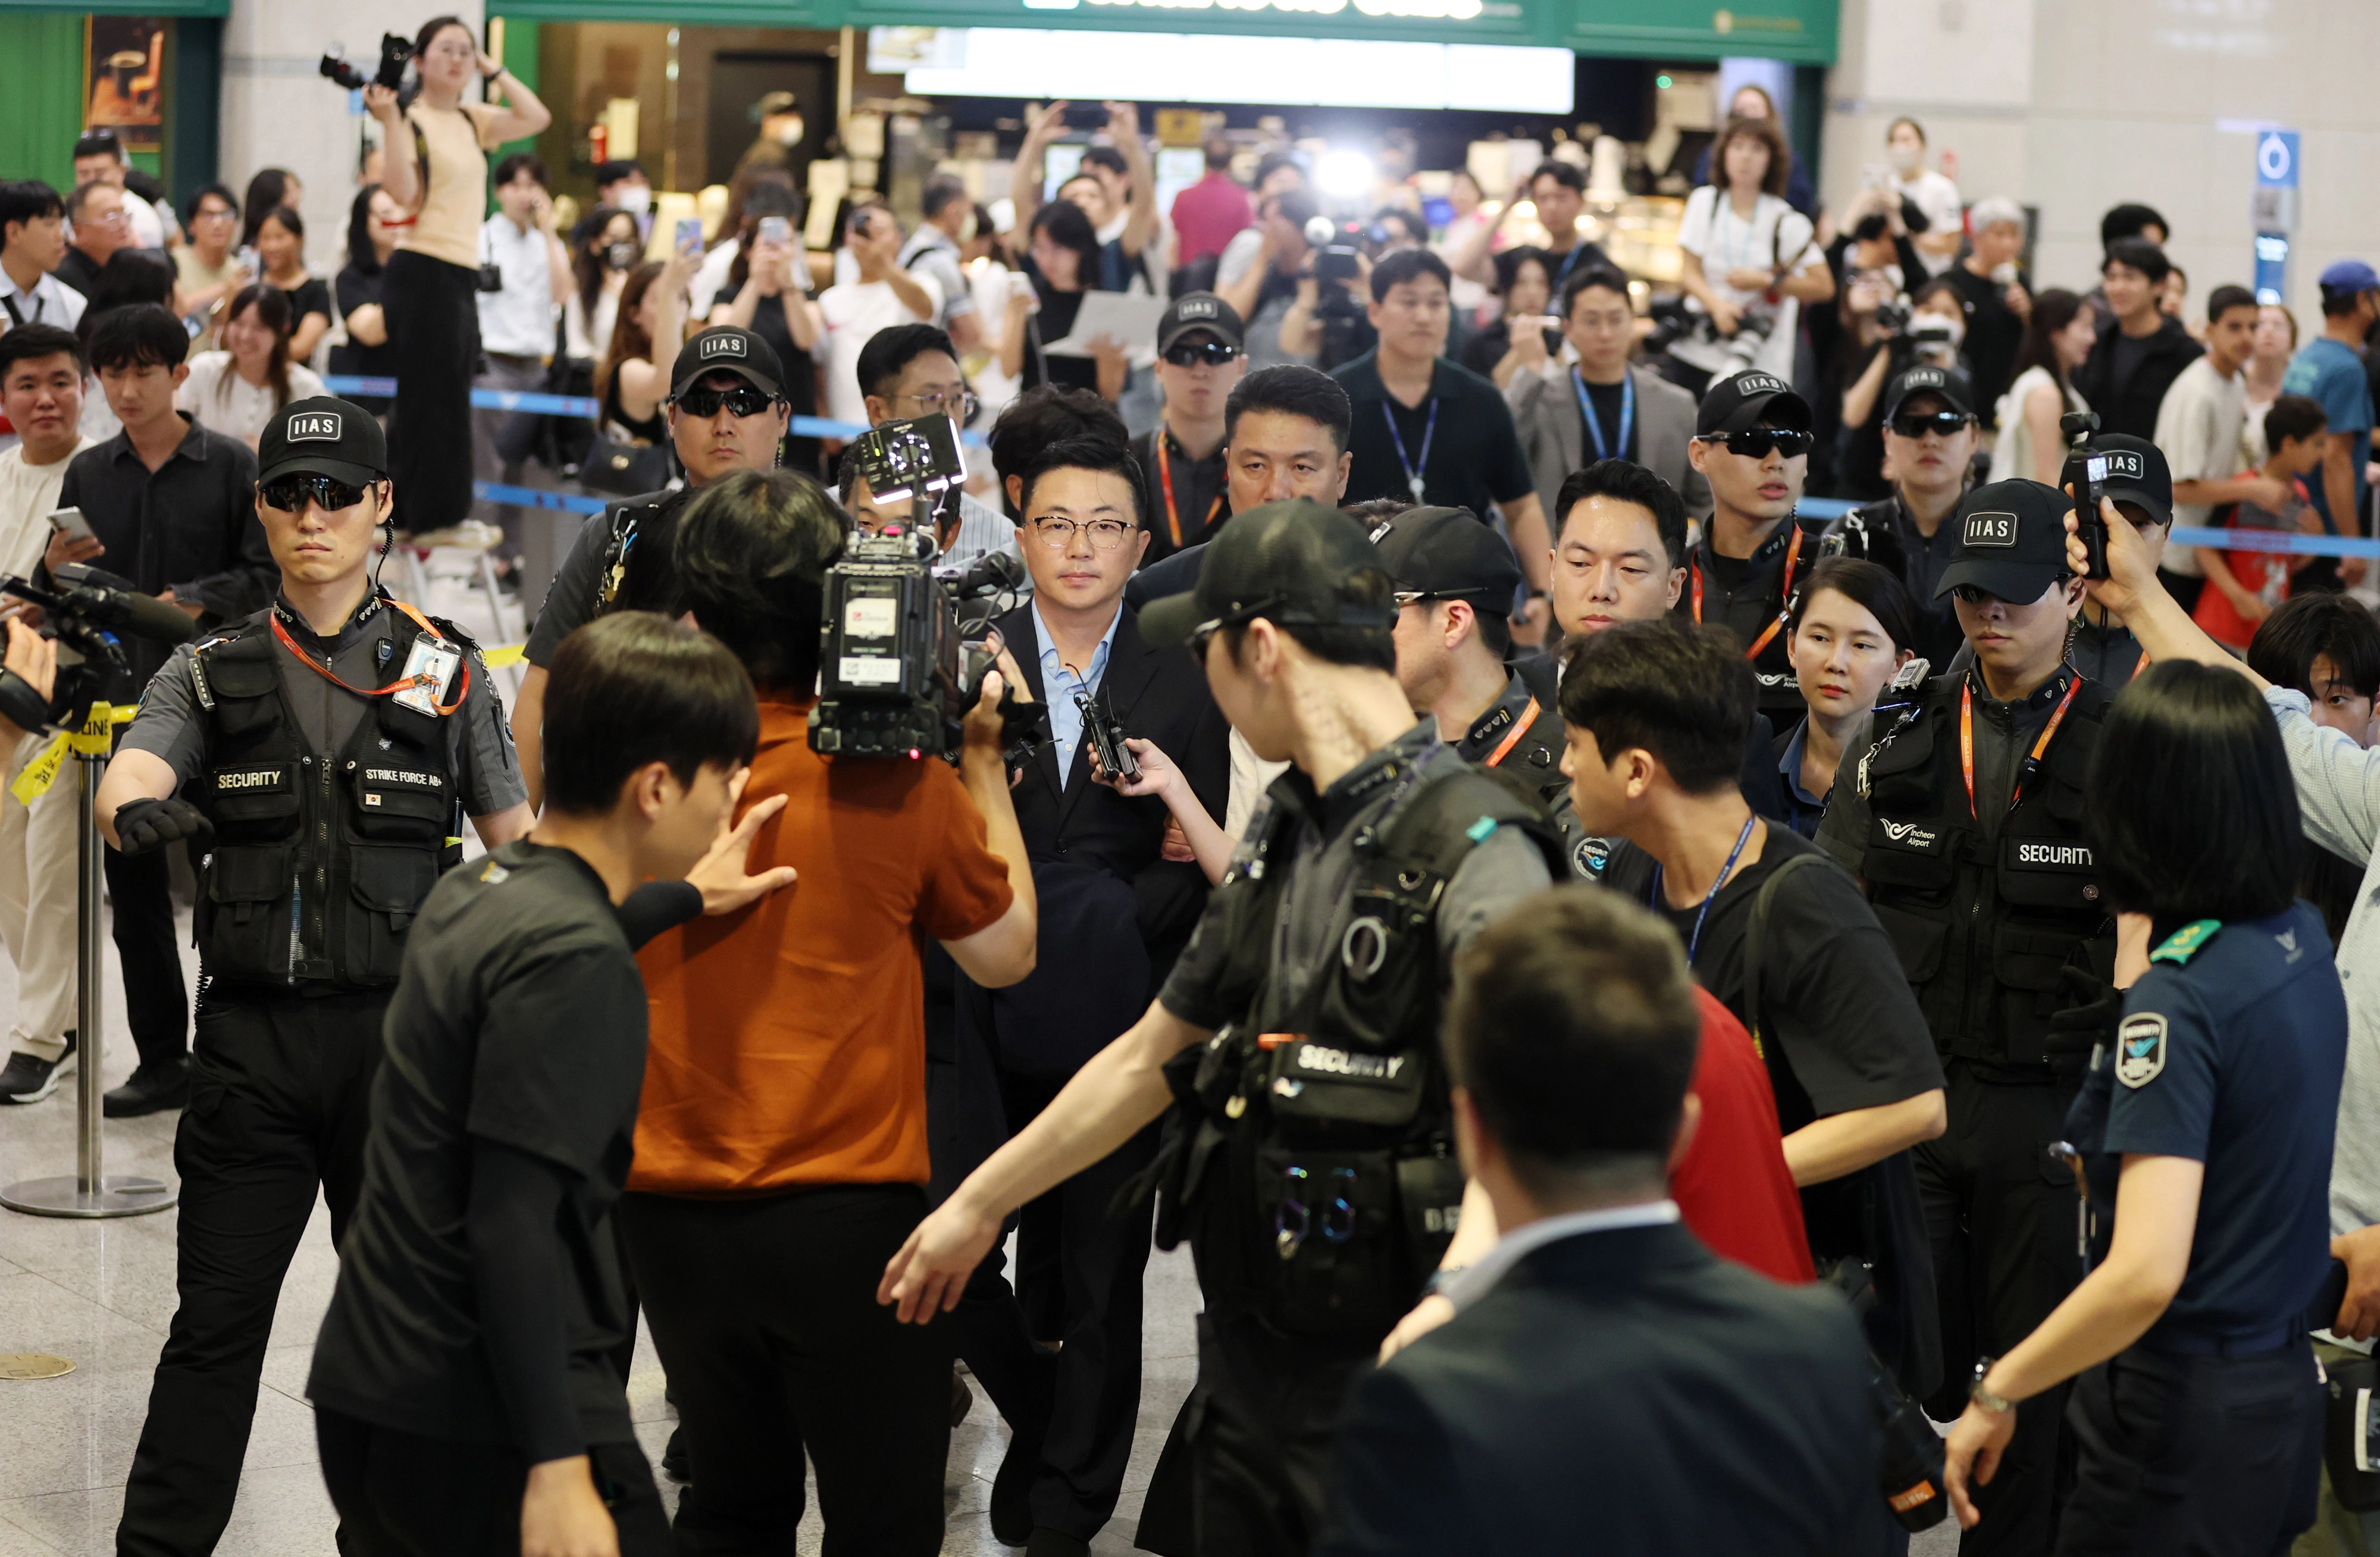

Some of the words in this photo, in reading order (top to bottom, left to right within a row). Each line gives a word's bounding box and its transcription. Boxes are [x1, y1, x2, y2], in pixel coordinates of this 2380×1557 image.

[706, 338, 740, 353] IIAS
[1745, 377, 1780, 390] IIAS
[295, 418, 333, 435] IIAS
[2108, 456, 2137, 471] IAS
[1969, 520, 2008, 537] IIAS
[218, 771, 281, 789] SECURITY
[365, 769, 398, 782] STRIKE
[399, 771, 427, 785] FORCE
[428, 775, 442, 787] AB+
[1910, 828, 1936, 839] Incheon
[1906, 837, 1930, 847] Airport
[2019, 844, 2093, 866] SECURITY
